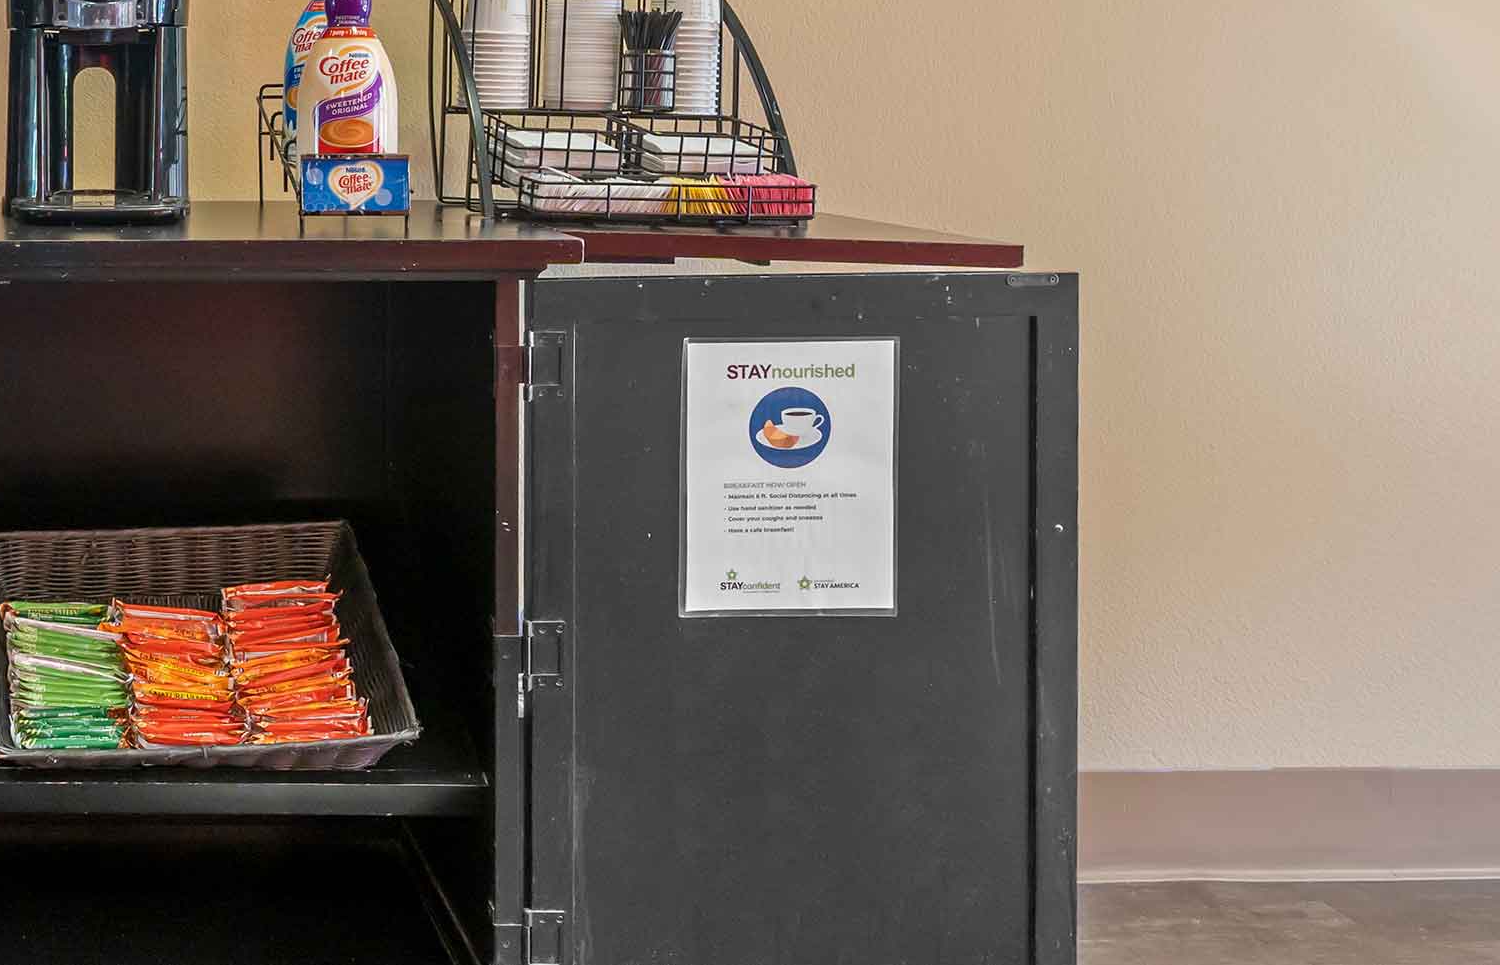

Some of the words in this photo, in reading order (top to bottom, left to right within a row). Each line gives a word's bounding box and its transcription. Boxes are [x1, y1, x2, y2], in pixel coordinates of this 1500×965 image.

[319, 56, 369, 77] Coffee
[329, 69, 367, 85] mate
[325, 92, 373, 111] SWEETENED
[331, 102, 368, 116] ORIGINAL
[338, 173, 369, 189] Coffee
[726, 363, 855, 380] STAYnourished
